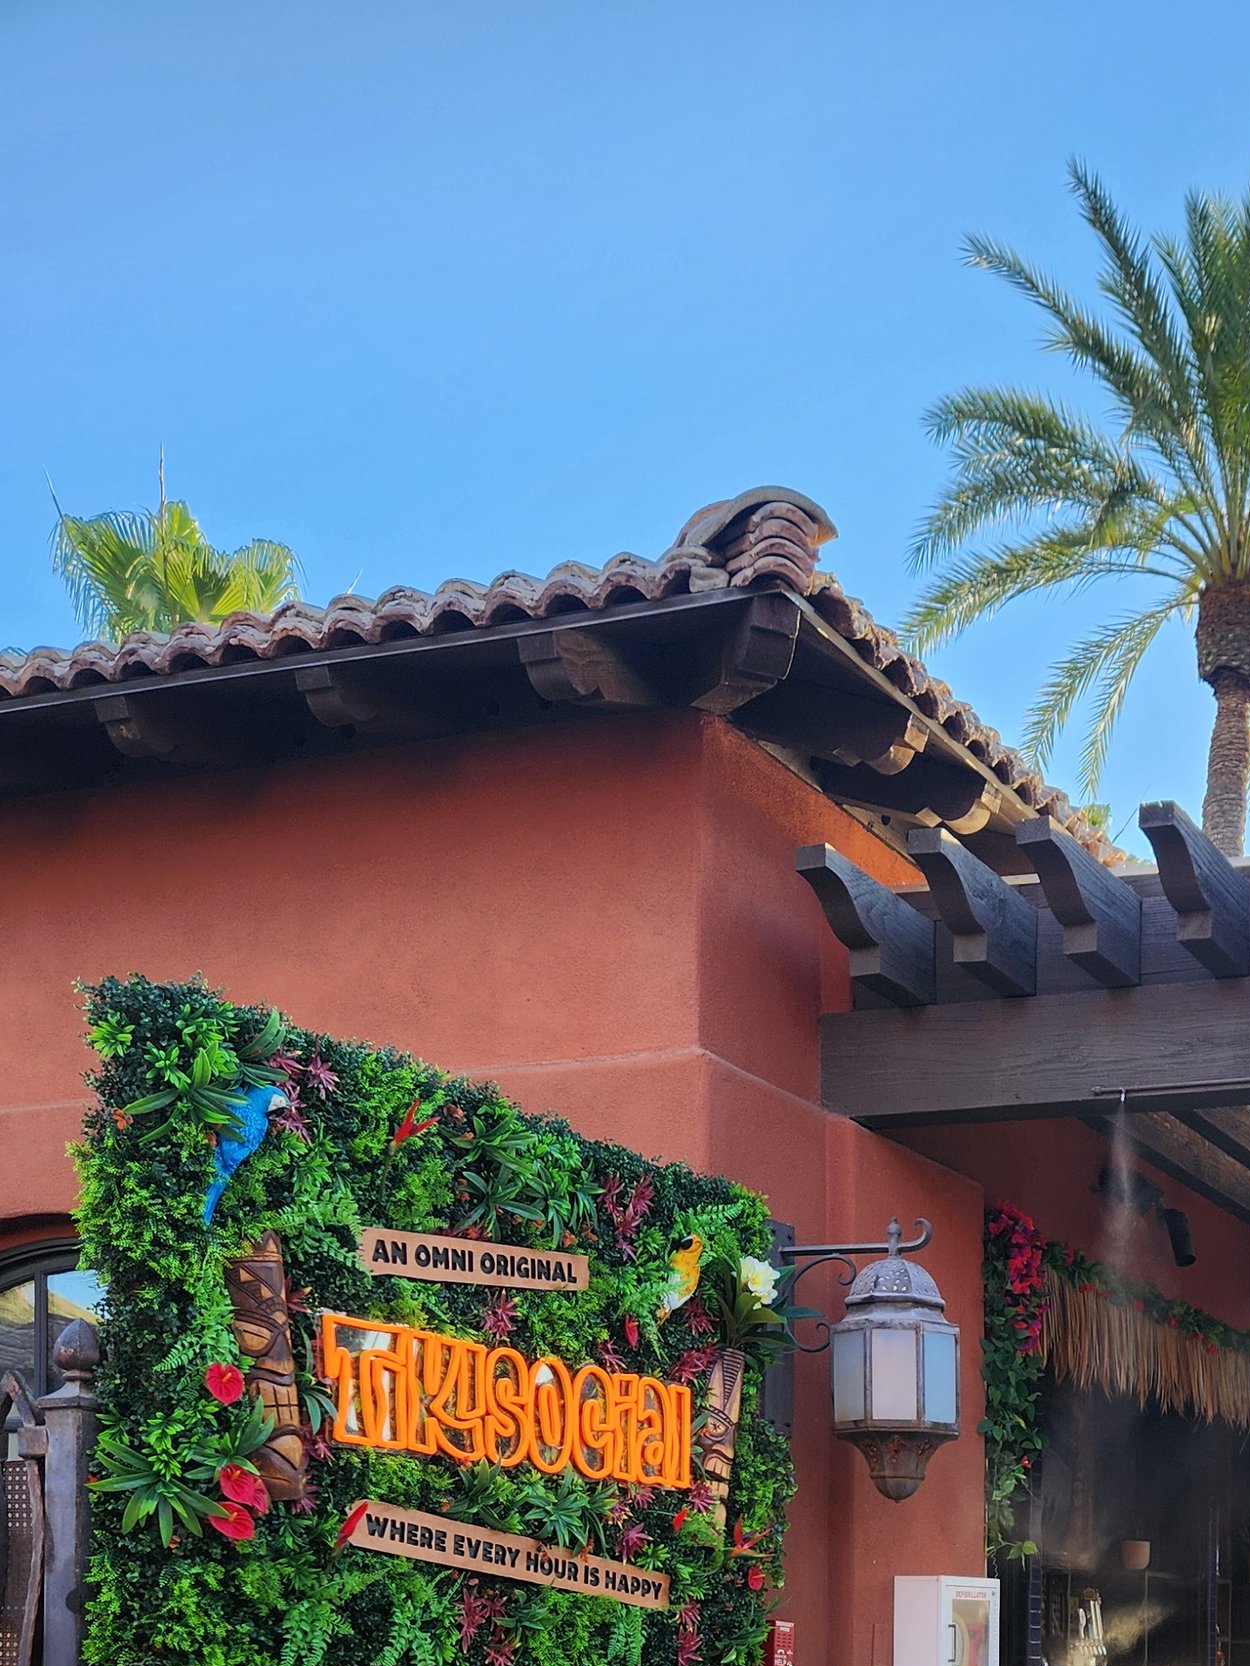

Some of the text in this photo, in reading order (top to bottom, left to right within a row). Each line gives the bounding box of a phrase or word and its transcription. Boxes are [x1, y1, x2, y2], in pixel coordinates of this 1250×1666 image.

[372, 1239, 577, 1283] AN OMNI ORIGINAL
[365, 1513, 663, 1600] WHERE EVERY HOUR IS HAPPY
